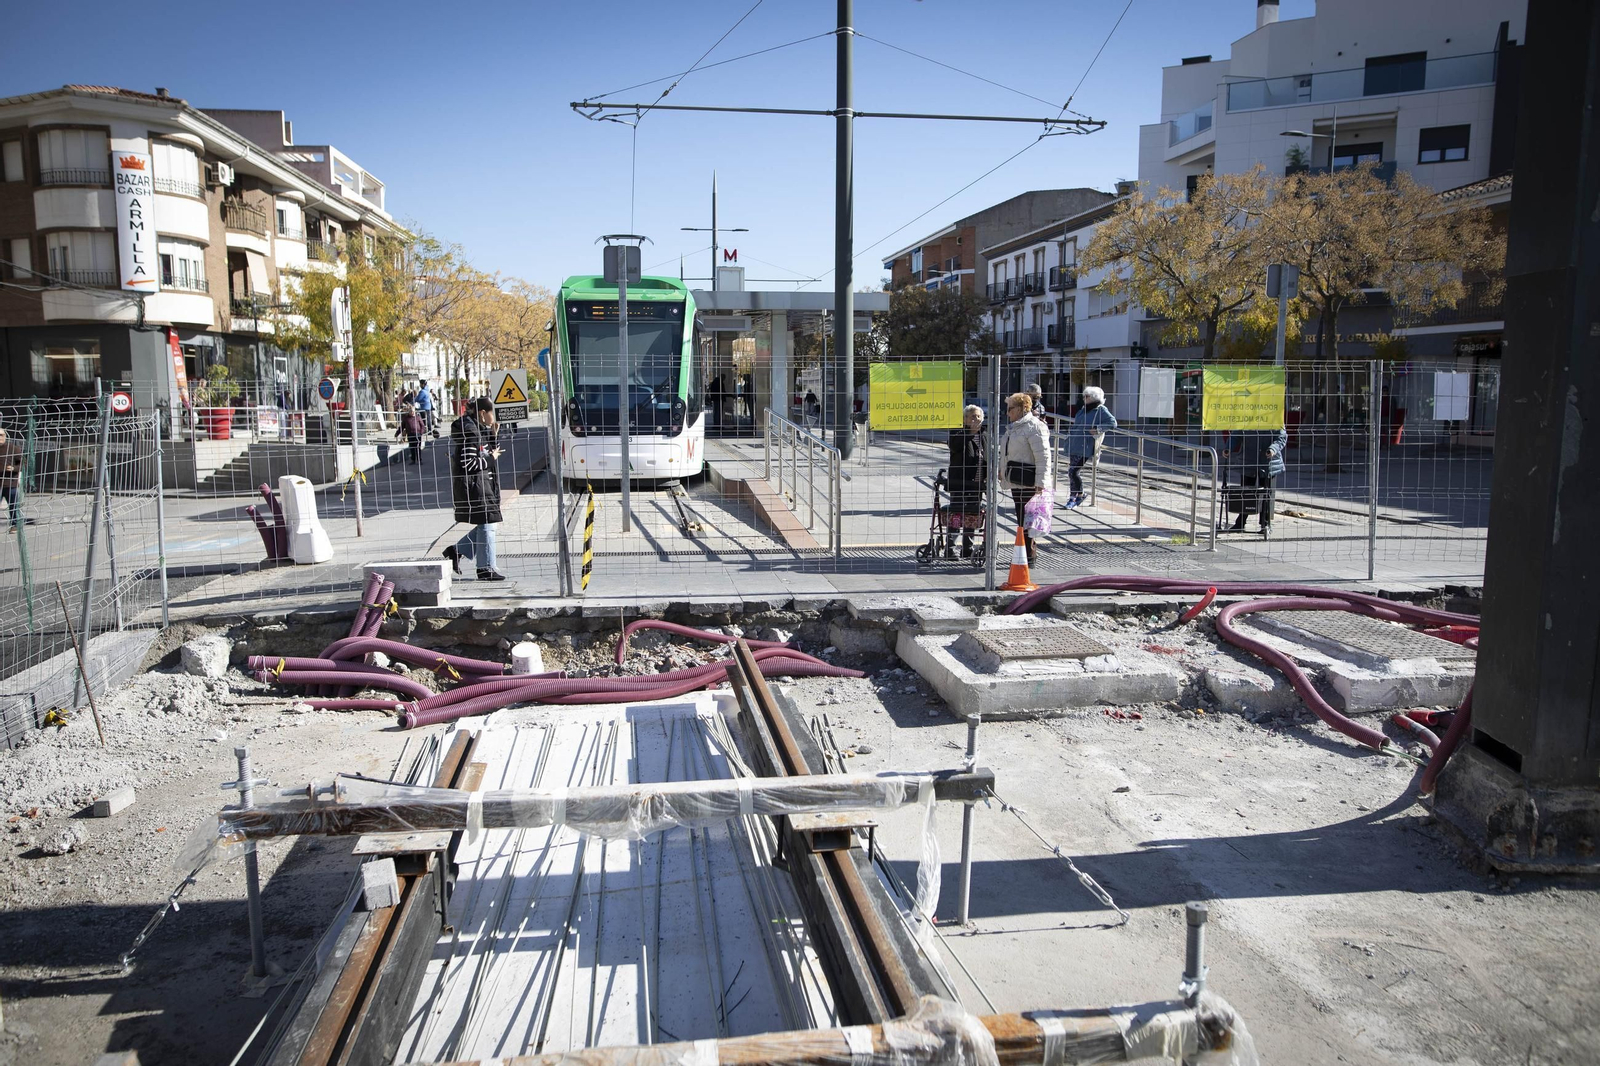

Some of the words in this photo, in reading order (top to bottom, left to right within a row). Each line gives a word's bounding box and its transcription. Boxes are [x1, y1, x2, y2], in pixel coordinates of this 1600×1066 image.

[117, 173, 150, 187] BAZAR
[118, 186, 151, 196] CASH
[129, 198, 146, 275] ARMILLA
[724, 248, 737, 262] M
[1460, 342, 1488, 353] cajasur
